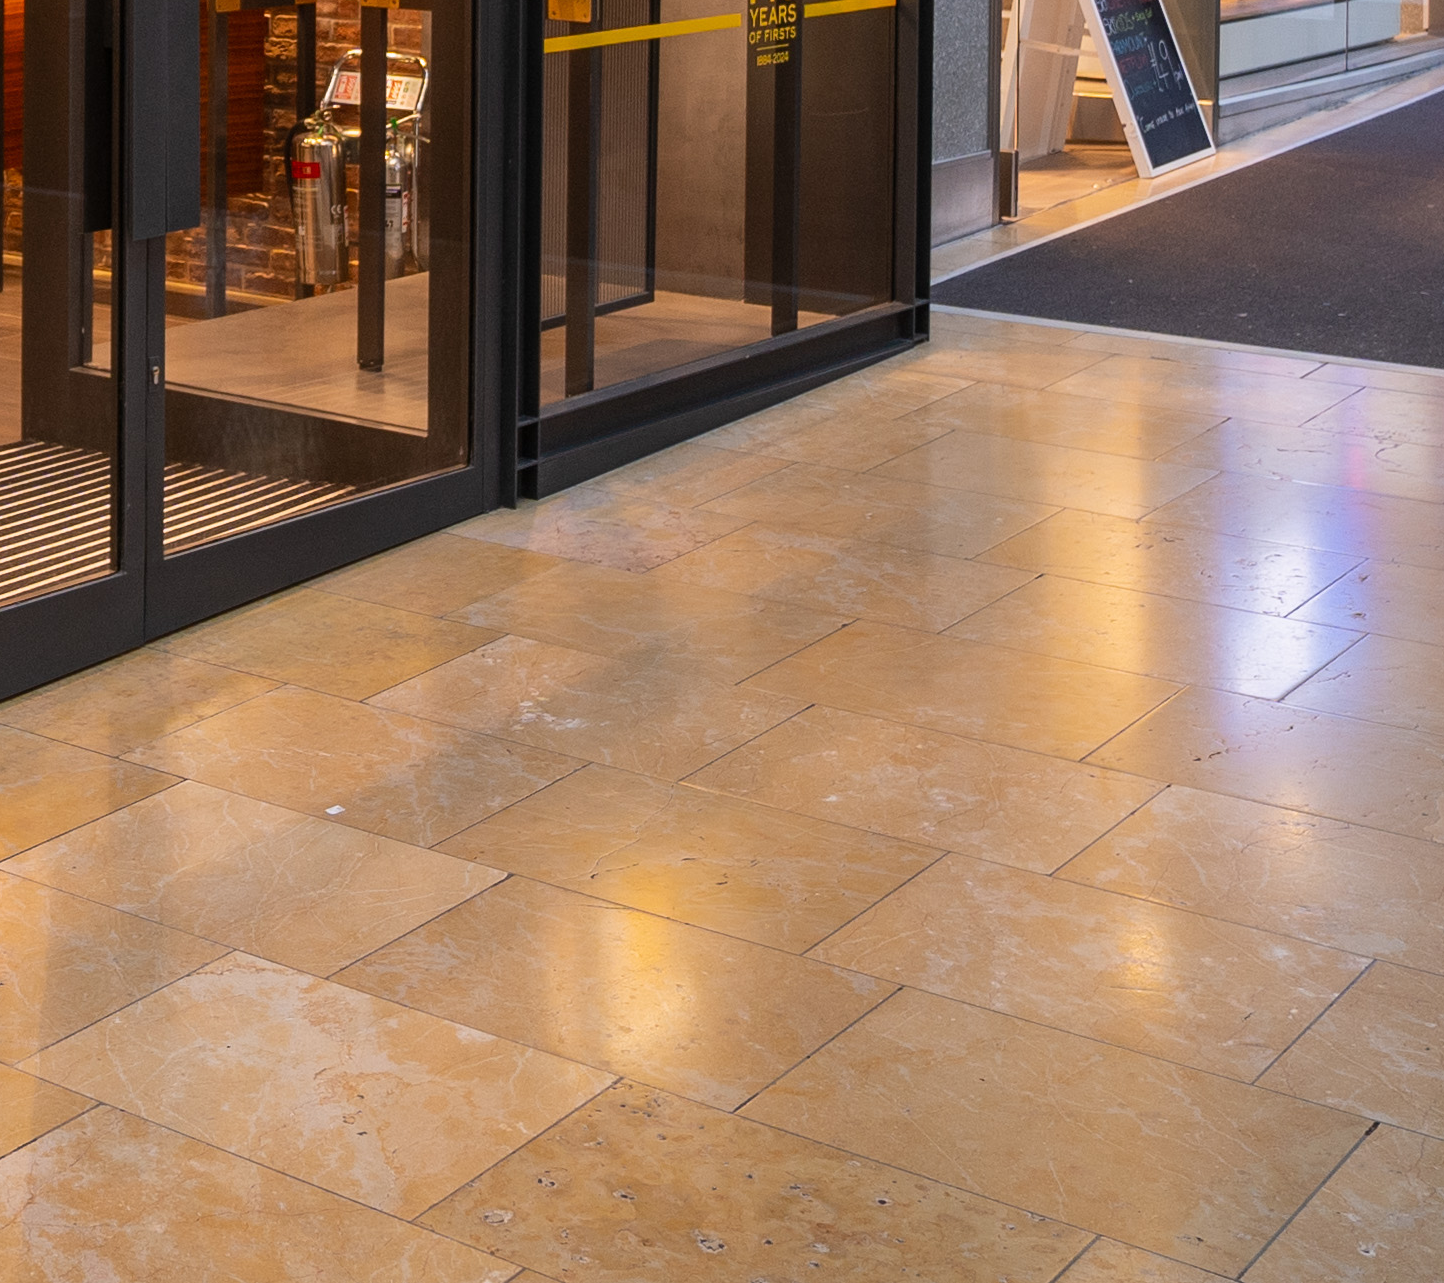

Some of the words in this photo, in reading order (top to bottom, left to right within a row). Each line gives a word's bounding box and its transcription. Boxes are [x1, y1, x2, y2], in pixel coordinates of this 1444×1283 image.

[750, 4, 797, 28] YEARS
[748, 30, 762, 45] OF
[764, 25, 796, 43] FIRSTS
